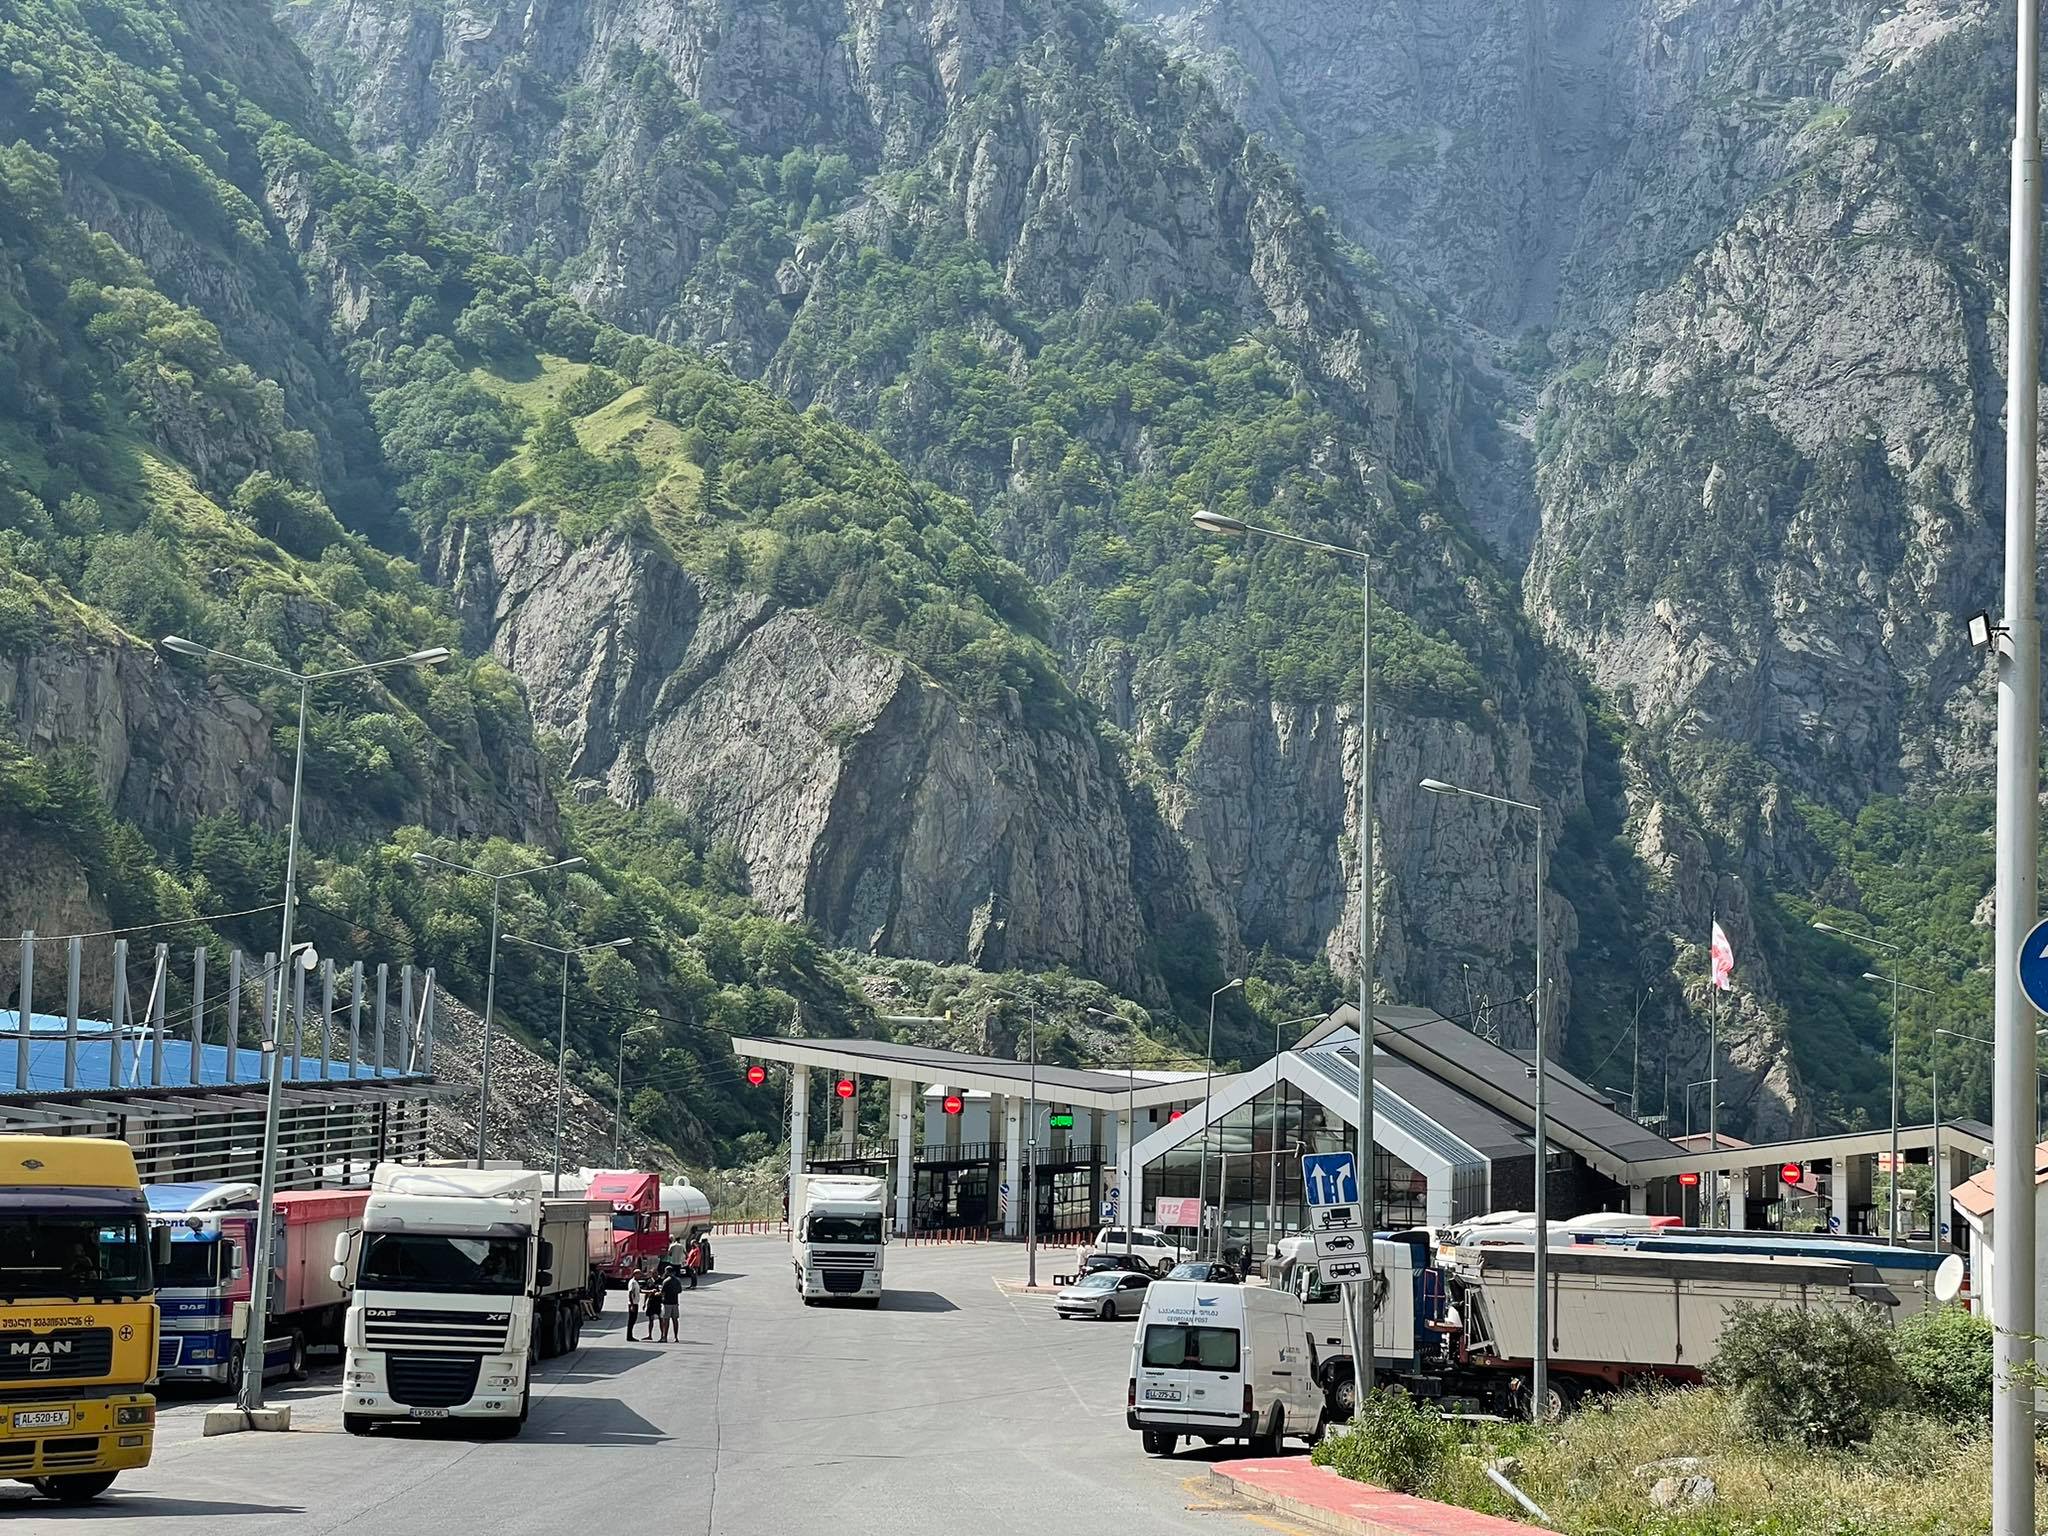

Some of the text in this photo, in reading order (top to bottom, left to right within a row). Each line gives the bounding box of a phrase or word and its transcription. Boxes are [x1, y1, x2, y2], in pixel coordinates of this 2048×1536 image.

[1160, 1204, 1179, 1214] 112
[367, 1309, 397, 1317] DAF
[10, 1341, 72, 1355] MAN
[22, 1412, 64, 1424] AL-520-EX
